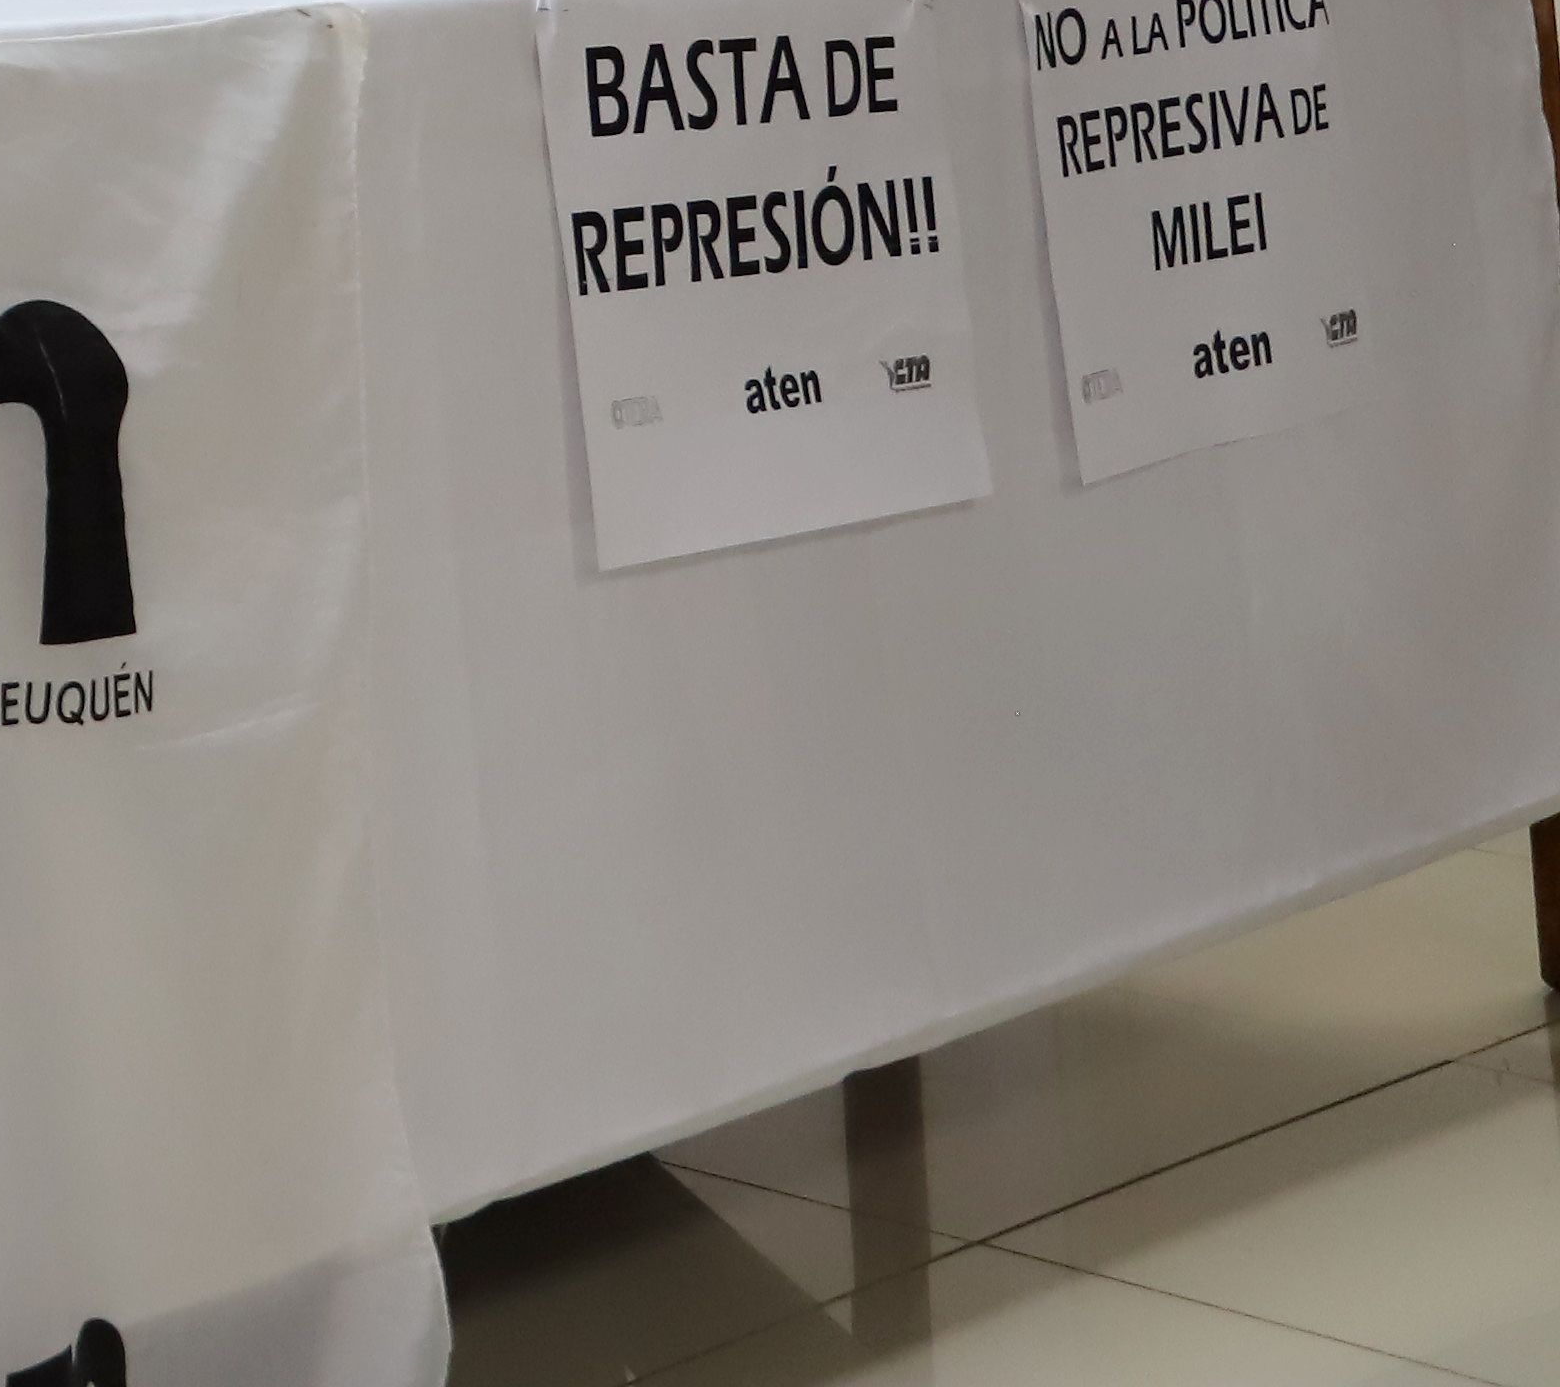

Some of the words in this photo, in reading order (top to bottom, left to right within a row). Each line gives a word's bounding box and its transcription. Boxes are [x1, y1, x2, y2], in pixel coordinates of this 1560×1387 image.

[1035, 7, 1087, 71] NO
[1101, 18, 1124, 60] A
[1131, 12, 1169, 55] LA
[585, 35, 810, 138] BASTA
[827, 35, 899, 118] DE
[1057, 82, 1286, 178] REPRESIVA
[1290, 83, 1330, 135] DE
[571, 165, 940, 296] REPRESIÓN!!
[1151, 192, 1268, 271] MILEI
[744, 364, 822, 415] aten
[1192, 329, 1273, 378] aten
